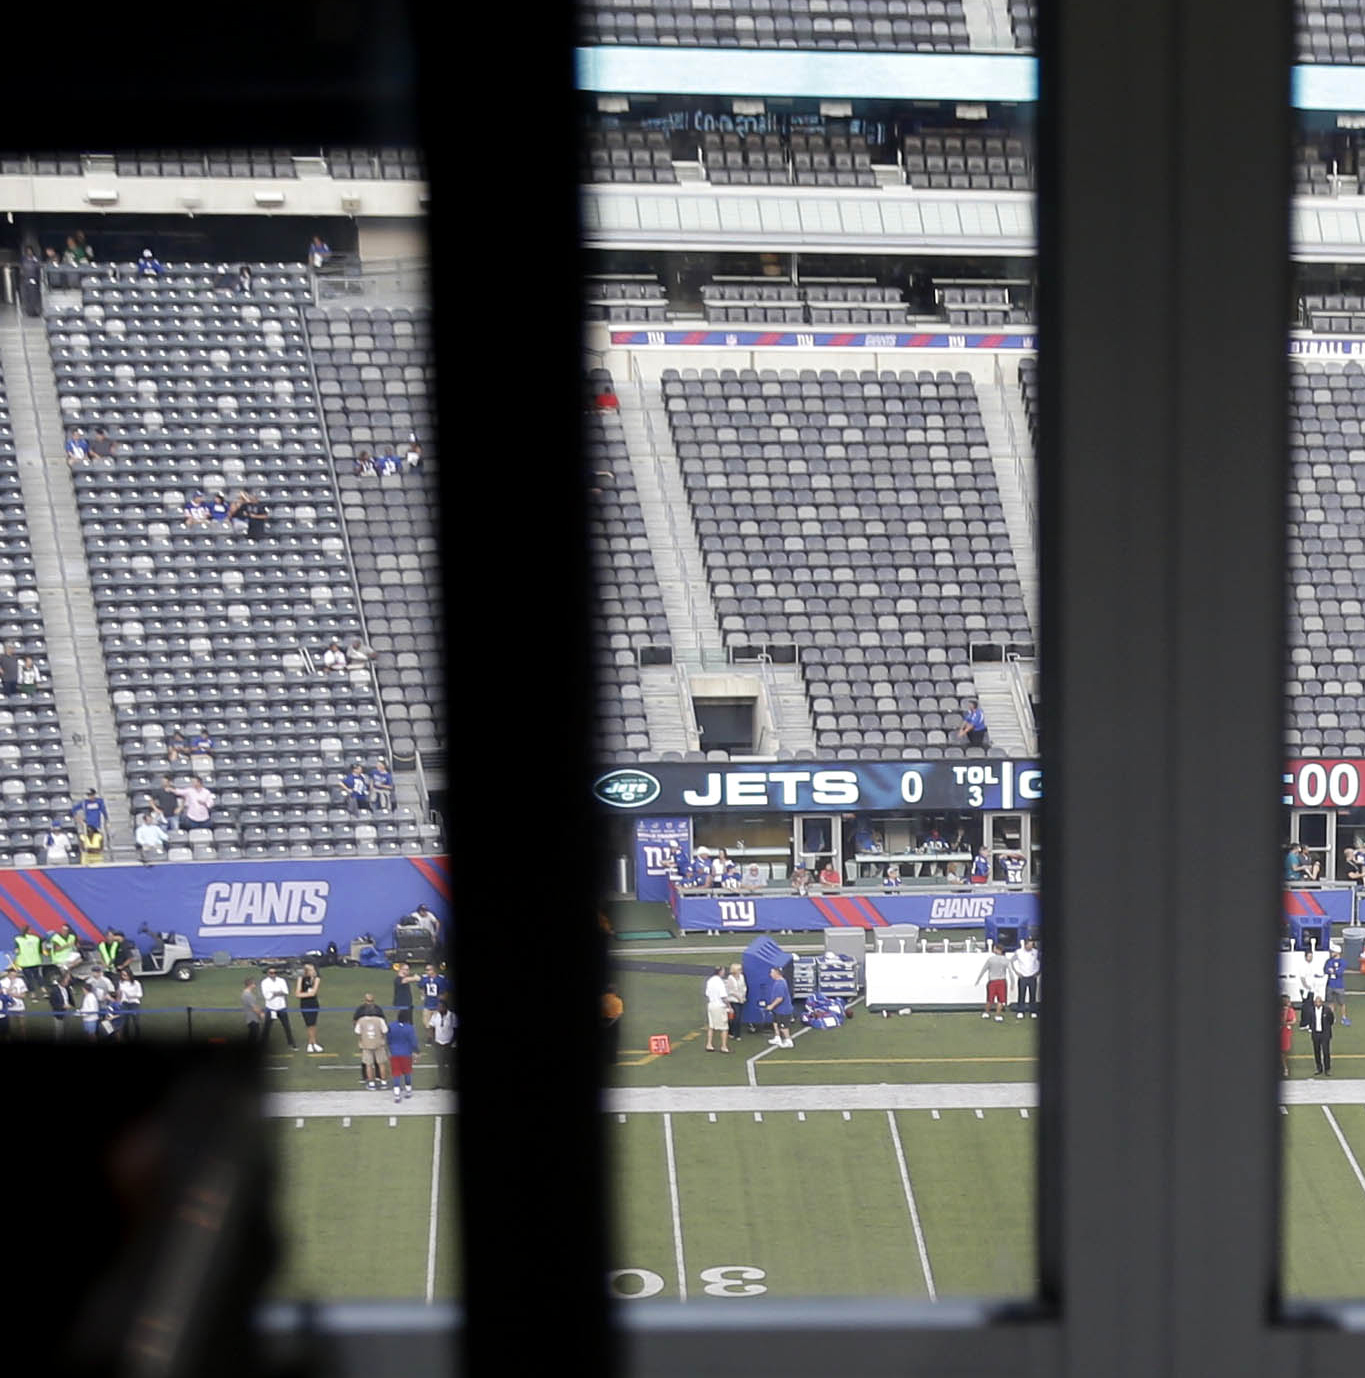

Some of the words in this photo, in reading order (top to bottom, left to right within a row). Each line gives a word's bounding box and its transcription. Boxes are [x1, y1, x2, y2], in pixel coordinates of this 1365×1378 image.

[952, 766, 999, 785] TOL
[683, 770, 860, 807] JETS
[900, 770, 924, 803] 0
[968, 785, 984, 808] 3
[201, 880, 330, 925] GIANTS
[930, 897, 995, 918] GIANTS
